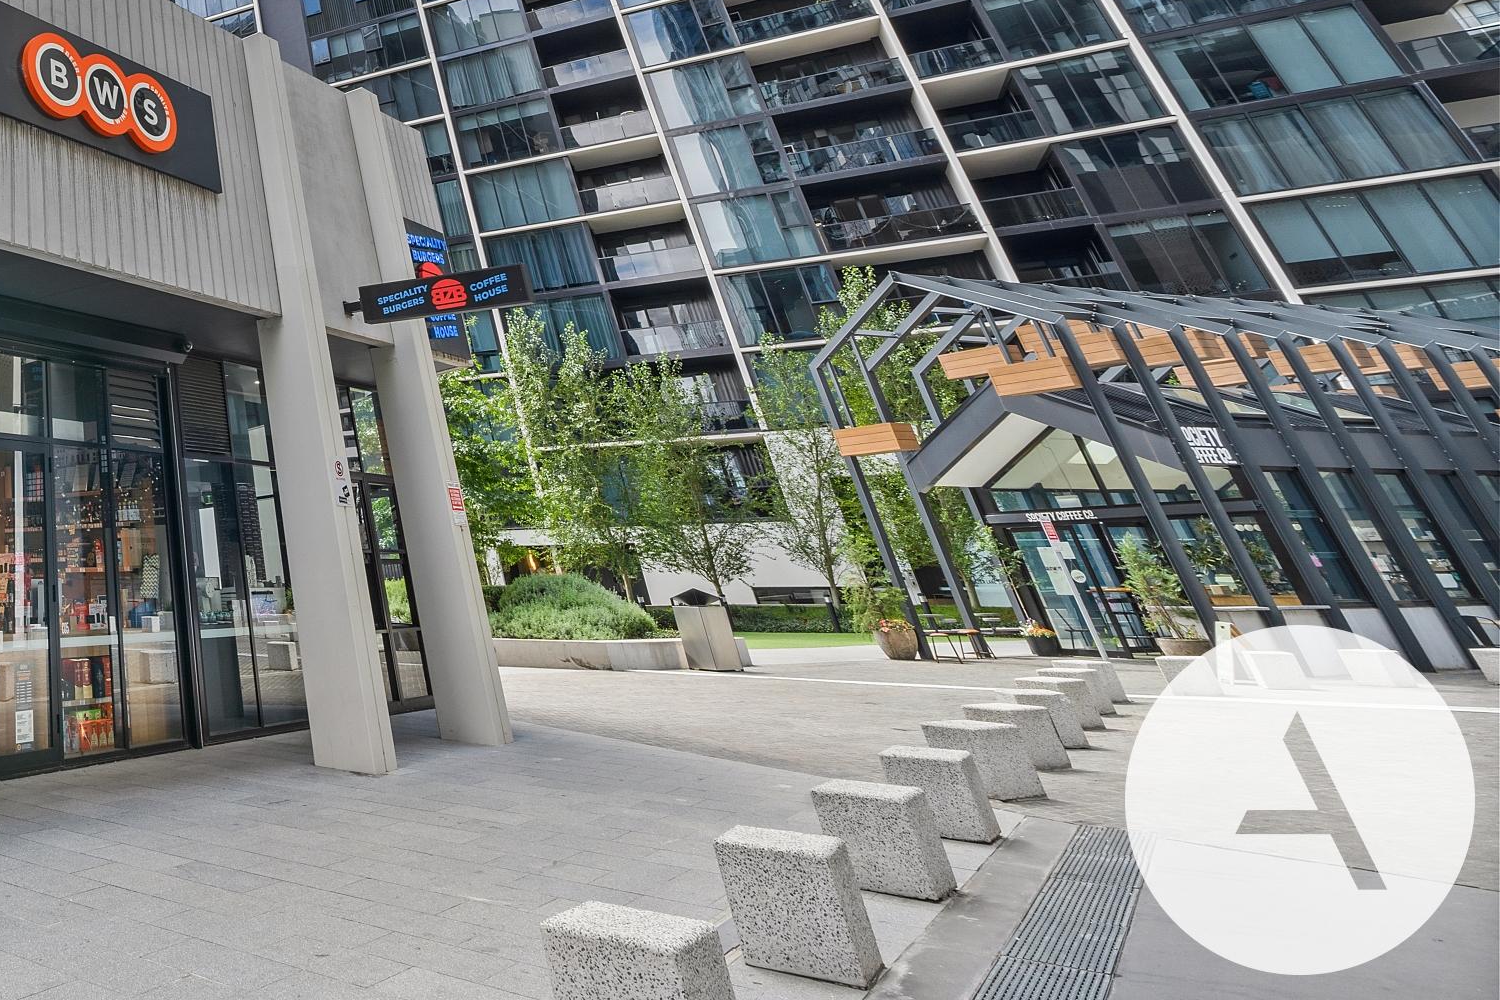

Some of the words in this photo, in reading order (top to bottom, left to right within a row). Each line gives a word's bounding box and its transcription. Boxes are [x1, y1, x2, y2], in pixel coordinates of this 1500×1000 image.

[64, 50, 80, 73] BEER
[115, 107, 128, 125] WINE
[406, 232, 447, 251] SPECIALITY
[411, 249, 445, 265] BURGERS
[469, 272, 508, 292] COFFEE
[377, 284, 428, 305] SPECIALITY
[474, 284, 509, 302] HOUSE
[382, 296, 425, 315] BURGERS
[433, 325, 459, 339] HOUSE
[1180, 426, 1224, 447] OCIETY
[1190, 447, 1222, 464] OFFEE
[1025, 511, 1056, 522] SOCIETY
[1056, 510, 1084, 521] COFFEE
